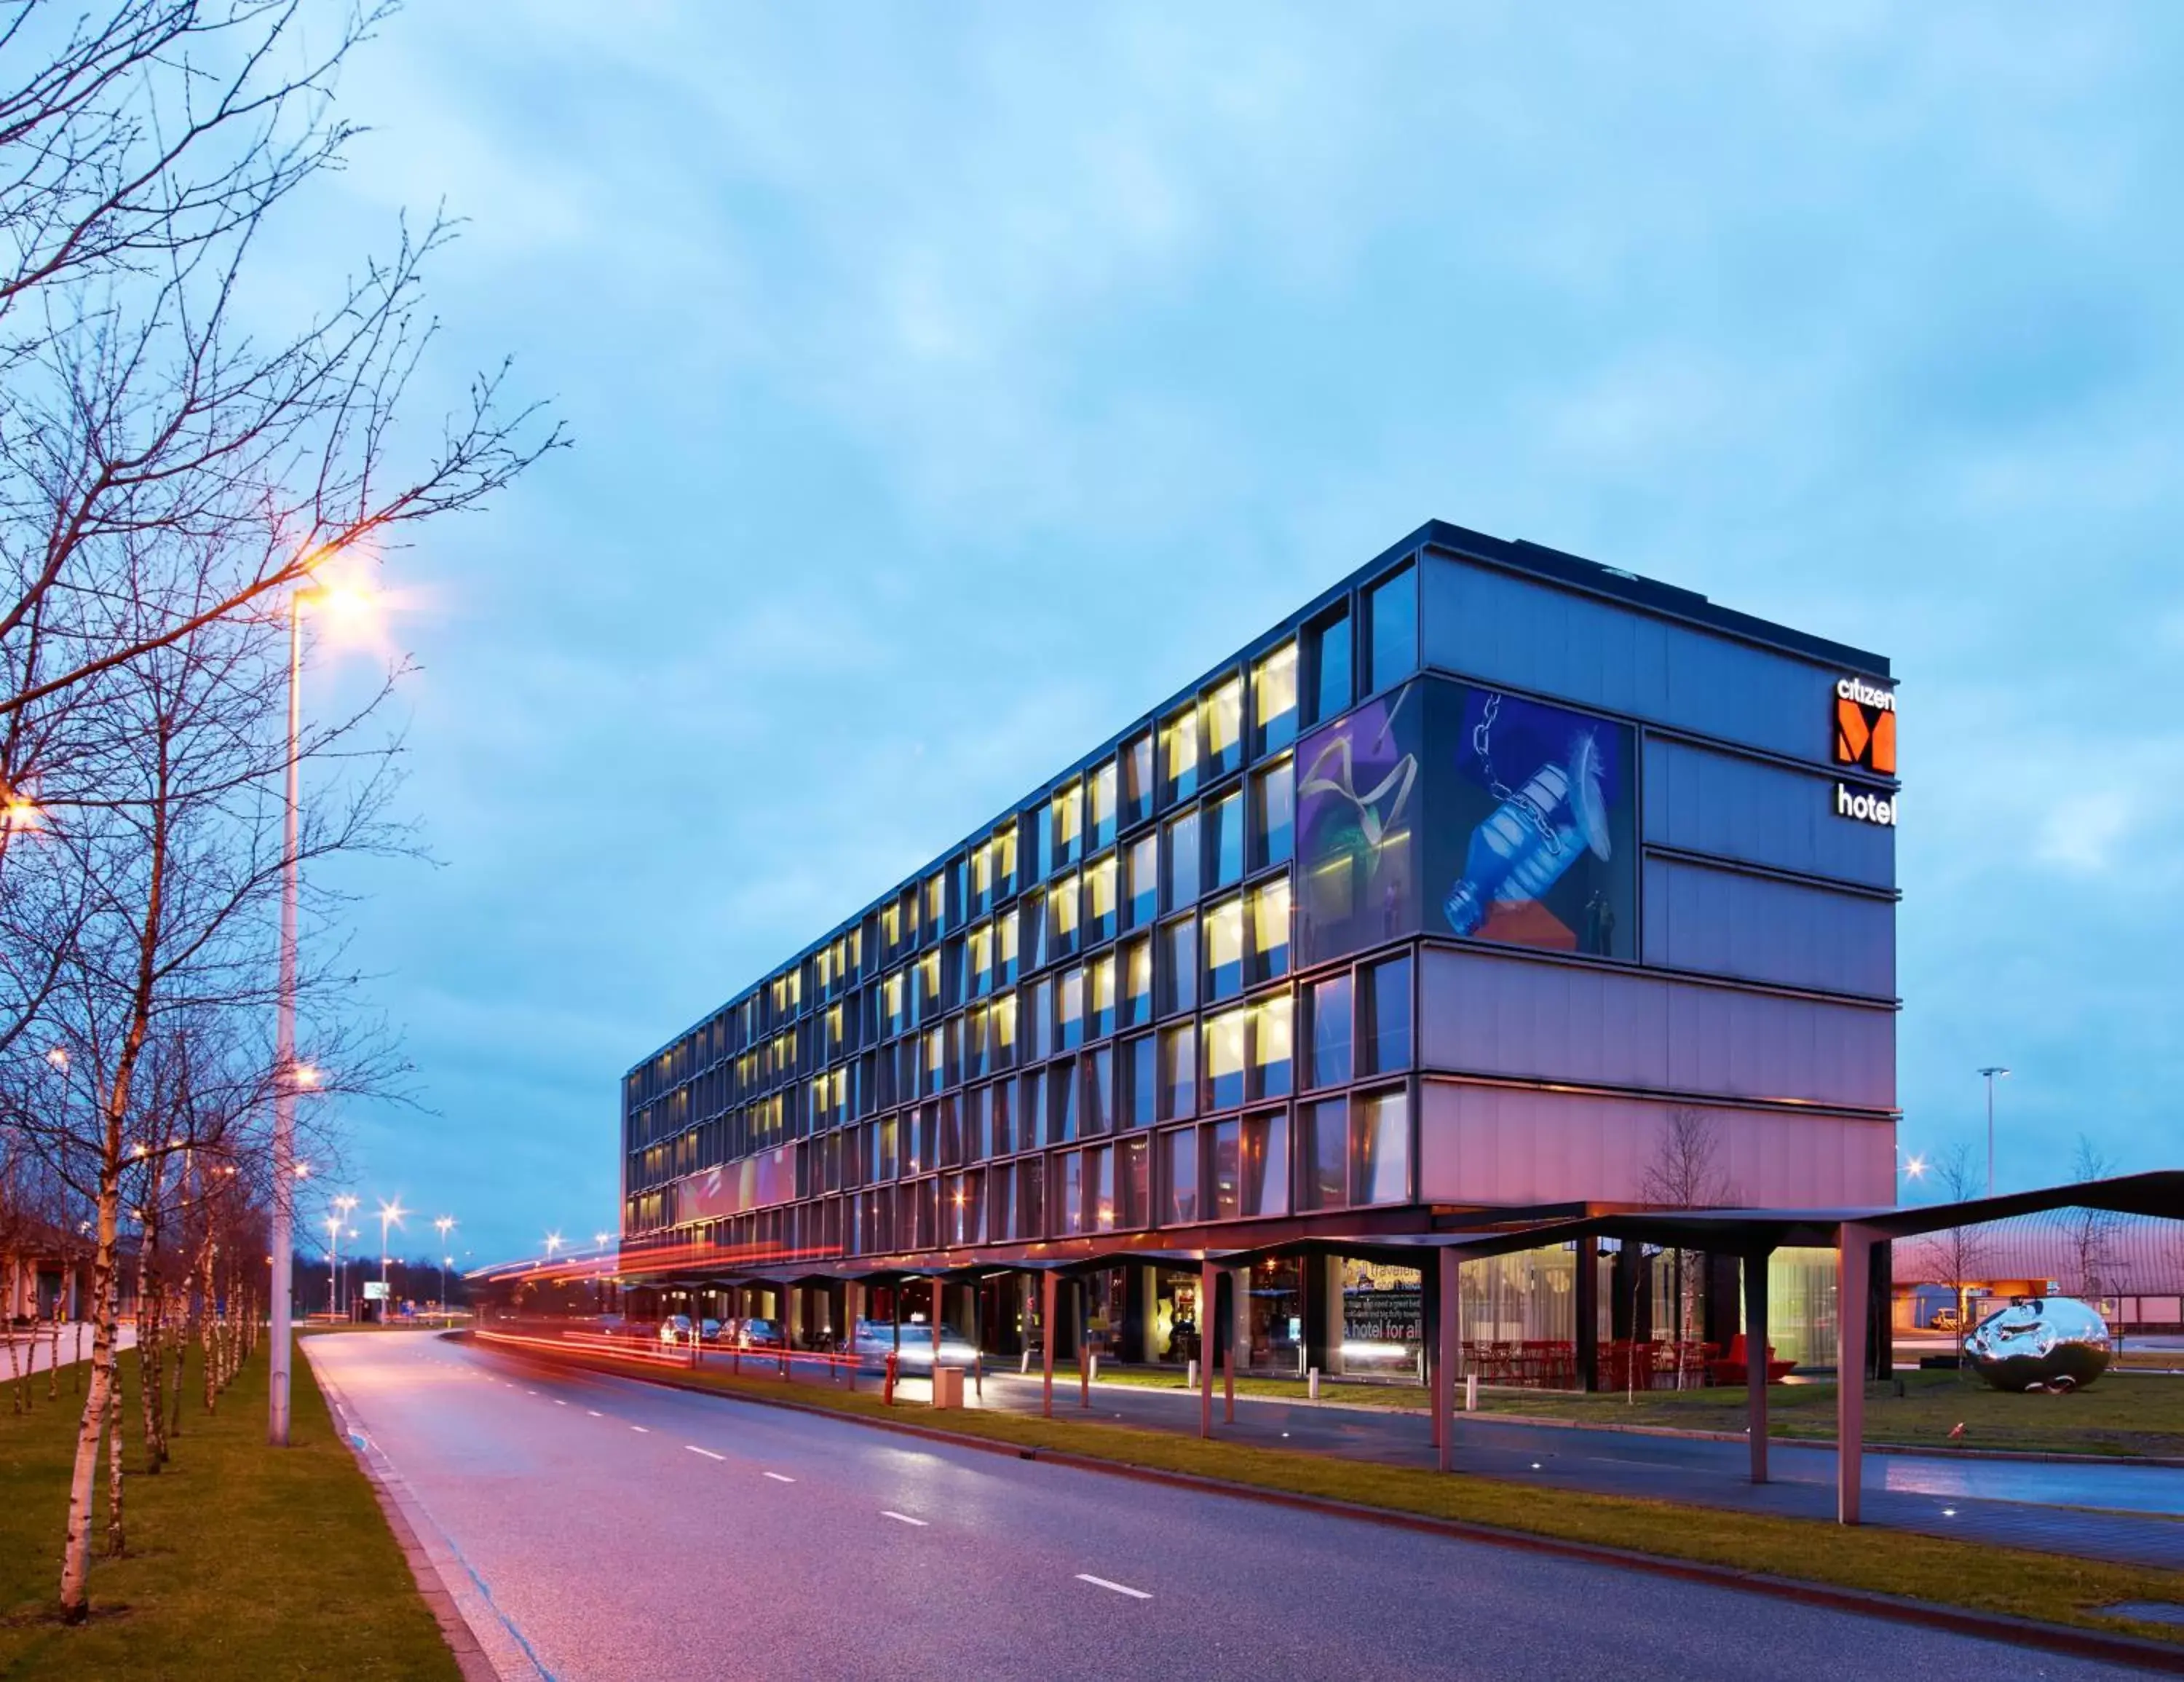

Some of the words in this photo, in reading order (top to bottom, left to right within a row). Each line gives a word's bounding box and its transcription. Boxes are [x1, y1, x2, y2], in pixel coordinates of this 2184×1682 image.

[1837, 678, 1895, 711] citizen
[1838, 698, 1896, 774] M
[1837, 783, 1897, 825] hotel
[1352, 1319, 1383, 1338] hotel
[1386, 1319, 1404, 1338] for
[1406, 1319, 1422, 1338] all
